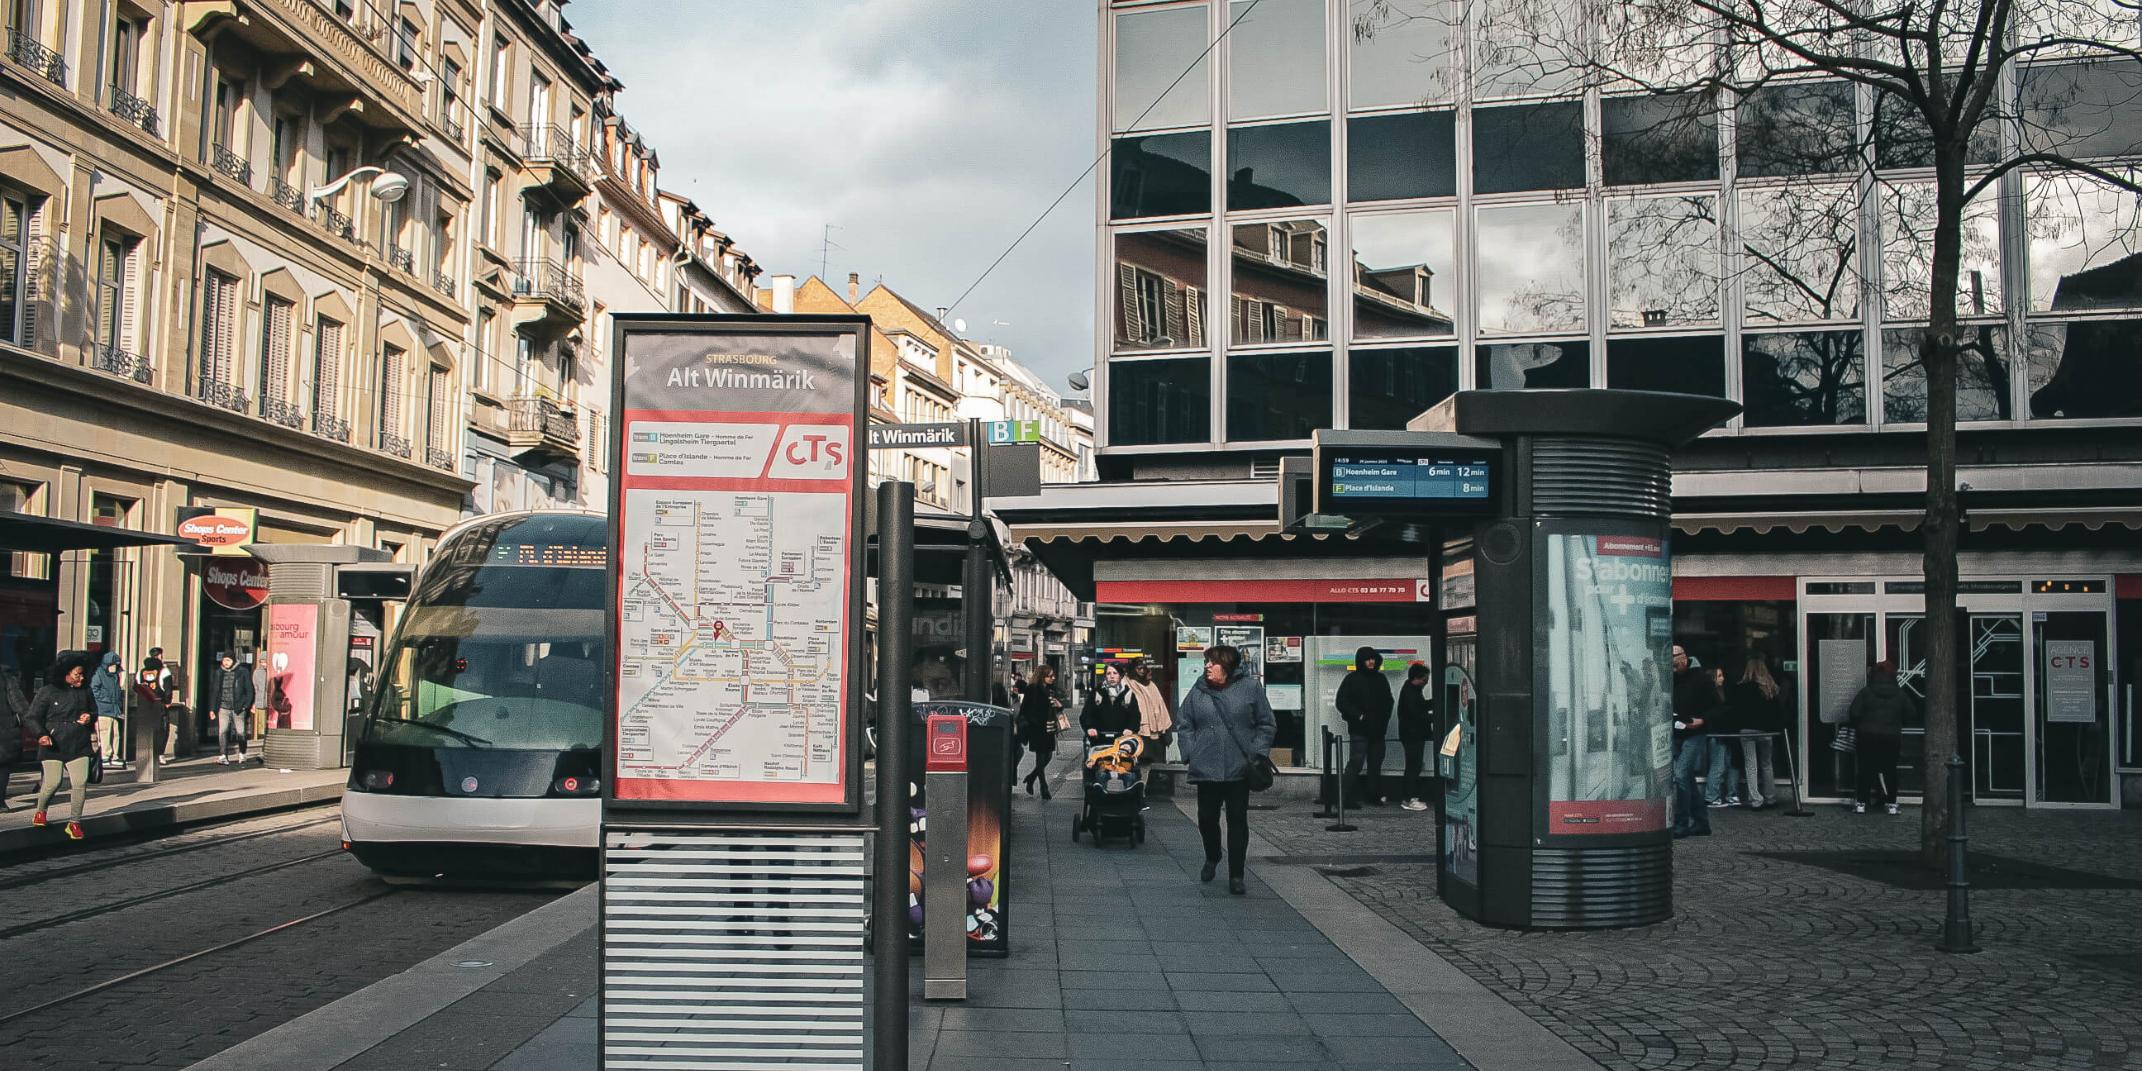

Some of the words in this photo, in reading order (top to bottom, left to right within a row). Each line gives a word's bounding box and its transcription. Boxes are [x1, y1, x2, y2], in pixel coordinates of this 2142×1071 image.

[705, 354, 777, 364] STRASBOURG
[666, 368, 700, 388] Alt
[704, 368, 816, 390] Winmärik
[868, 429, 880, 444] lt
[882, 428, 955, 444] Winmärik
[994, 420, 1009, 442] B
[1020, 420, 1032, 441] F
[1429, 467, 1435, 476] 6
[1458, 467, 1470, 476] 12
[1463, 483, 1470, 492] 8
[184, 523, 214, 535] Shops
[216, 524, 248, 535] Center
[201, 535, 226, 543] Sports
[1603, 543, 1644, 551] Abonnement
[207, 566, 238, 589] Shops
[270, 624, 299, 632] sbourg
[2051, 656, 2090, 668] CTS
